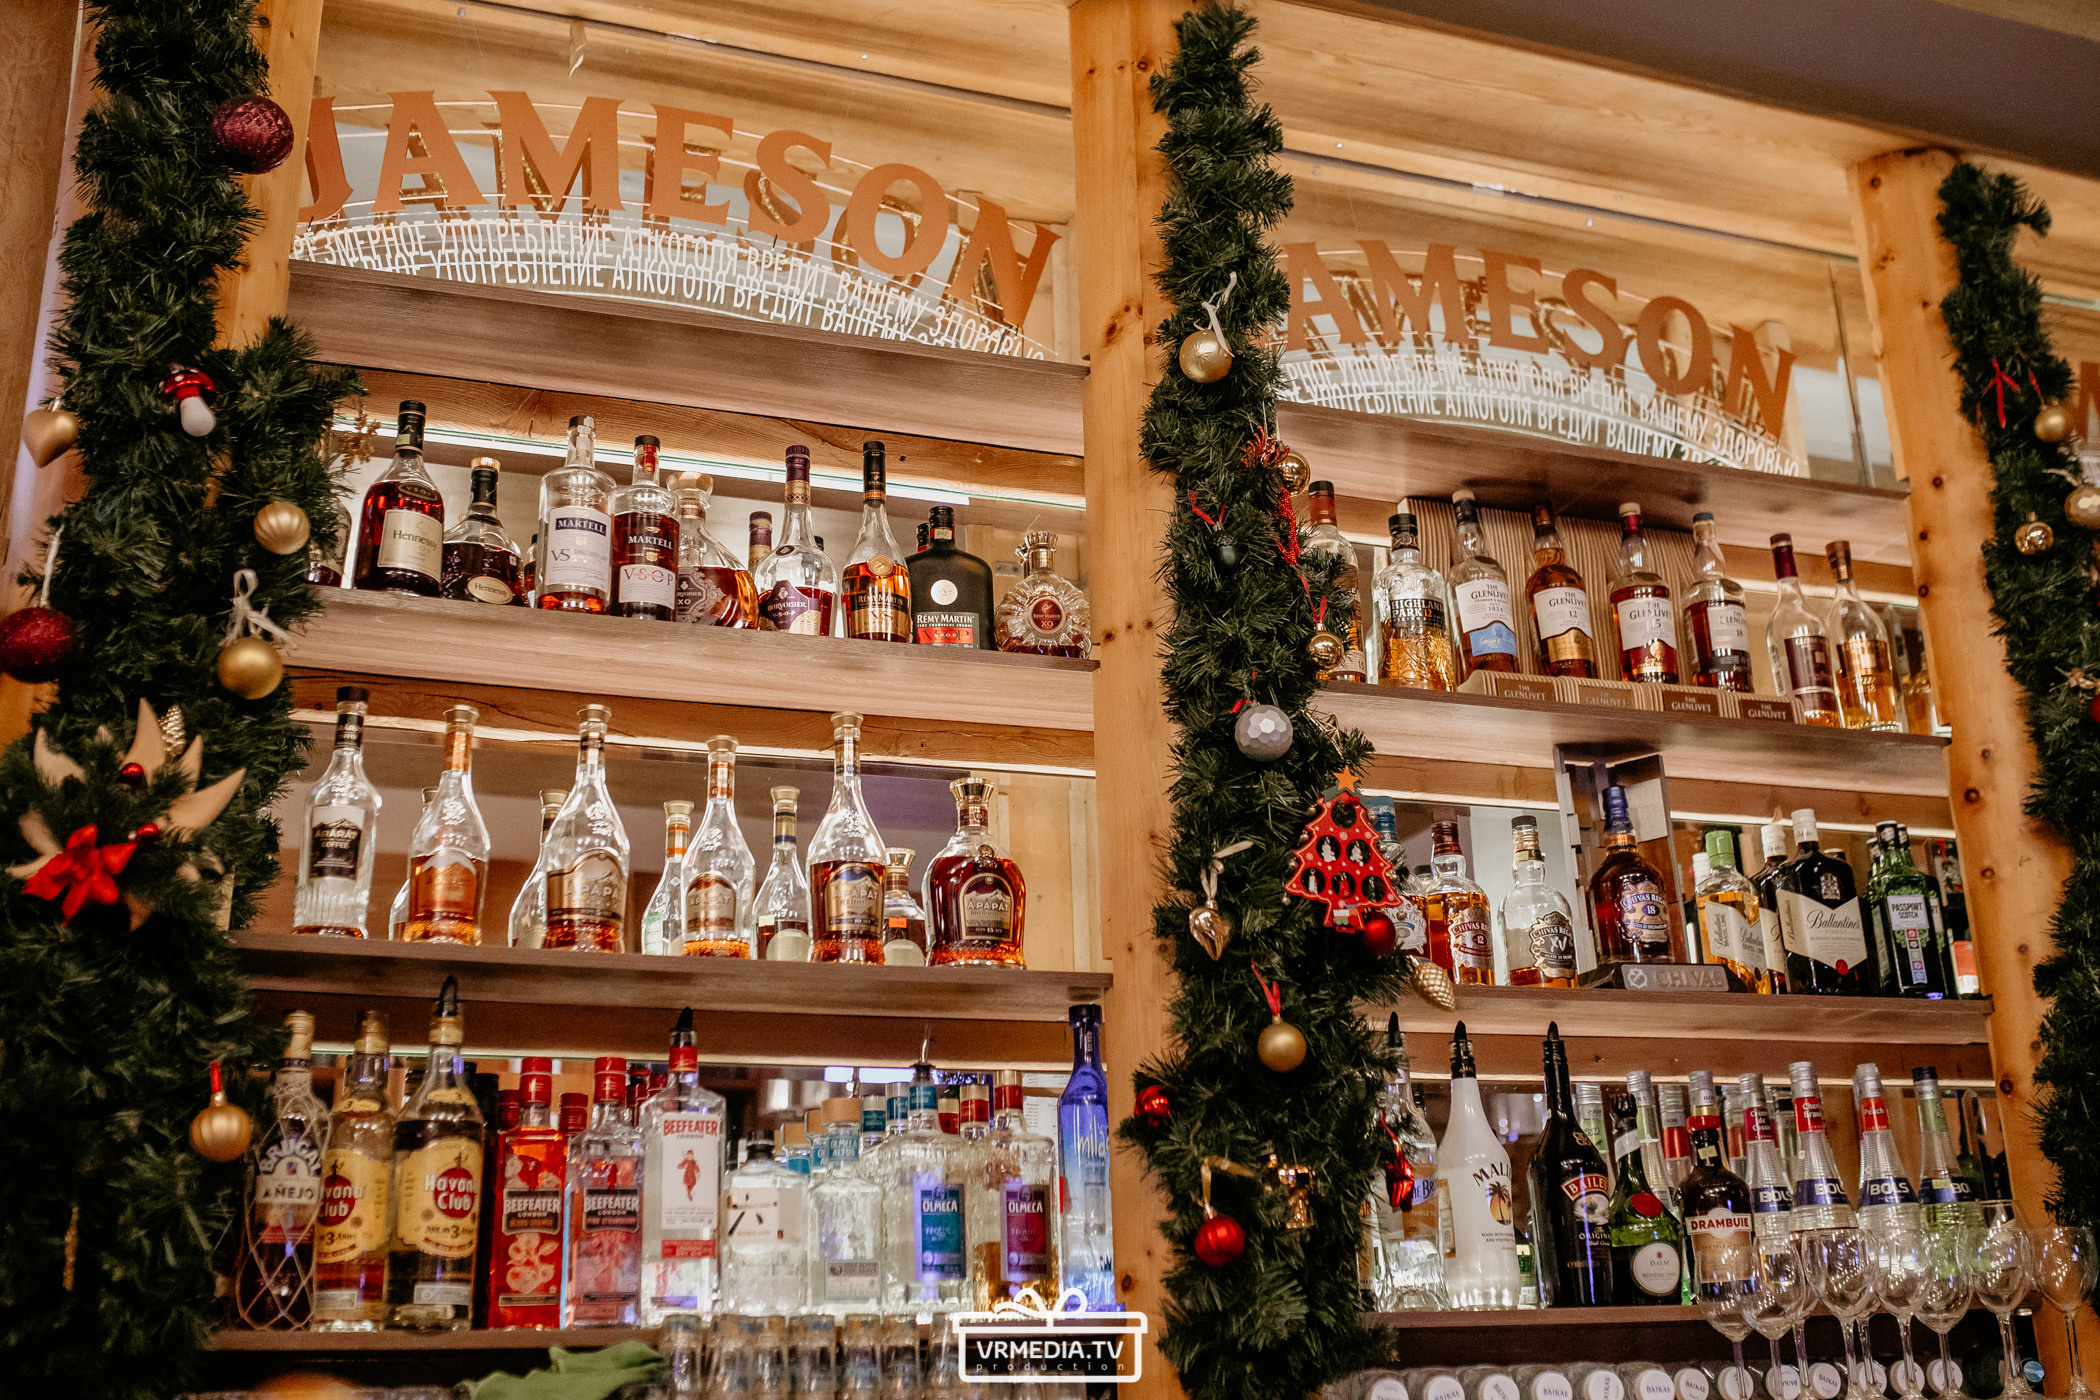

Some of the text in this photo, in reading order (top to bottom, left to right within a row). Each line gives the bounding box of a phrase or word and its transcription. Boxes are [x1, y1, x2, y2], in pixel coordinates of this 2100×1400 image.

[299, 90, 1060, 328] JAMESON
[623, 226, 738, 277] АЛКОГОЛЯ
[746, 246, 832, 298] ВРЕДИТ
[836, 270, 930, 329] ВАШЕМУ
[1279, 238, 1796, 443] AMESON
[1639, 391, 1709, 444] ВАШЕМУ
[558, 519, 605, 534] MARTELL
[392, 529, 437, 551] Hennessy
[628, 535, 673, 550] MARTELL
[551, 548, 571, 562] VS
[474, 582, 507, 597] Hennessy
[917, 613, 973, 624] RÉMY MARTIN
[1392, 608, 1433, 618] PARK 12
[1568, 610, 1578, 618] 12
[1041, 620, 1054, 628] XO
[1503, 689, 1546, 701] GLENLIVET
[1518, 684, 1531, 692] THE
[1671, 701, 1712, 713] GLENLIVET
[1747, 708, 1787, 720] GLENLIVET
[1760, 703, 1772, 711] THE
[313, 827, 358, 840] ARARAT
[320, 840, 350, 850] COFFEE
[967, 900, 1010, 912] АРАРАТ
[1622, 893, 1651, 909] CHIVAS
[1891, 901, 1923, 912] PASSPORT
[1646, 904, 1656, 915] 18
[1898, 911, 1919, 919] SCOTCH
[1807, 908, 1860, 930] Ballantine's
[1452, 921, 1480, 934] CHIVAS
[1533, 926, 1559, 938] CHIVAS
[1477, 935, 1485, 945] 12
[1549, 935, 1568, 953] XV
[1654, 968, 1724, 988] CHIVAS
[1863, 1106, 1885, 1116] Peach
[663, 1119, 718, 1138] BEEFEATER
[1077, 1114, 1110, 1158] mila
[829, 1138, 858, 1150] OLMECA
[831, 1149, 856, 1158] ALTOS
[1472, 1161, 1512, 1188] MALI
[262, 1183, 314, 1200] AÑEJO
[325, 1184, 365, 1199] vana
[1870, 1182, 1910, 1196] BOLS
[1950, 1182, 1972, 1194] BO
[437, 1192, 472, 1212] Club
[1759, 1189, 1793, 1203] BOLS
[503, 1198, 561, 1215] BEEFEATER
[583, 1195, 640, 1213] BEEFEATER
[922, 1199, 958, 1213] OLMECA
[1008, 1200, 1043, 1214] OLMECA
[1690, 1216, 1749, 1231] DRAMBUIE
[326, 1232, 335, 1246] 3
[450, 1225, 460, 1239] 3
